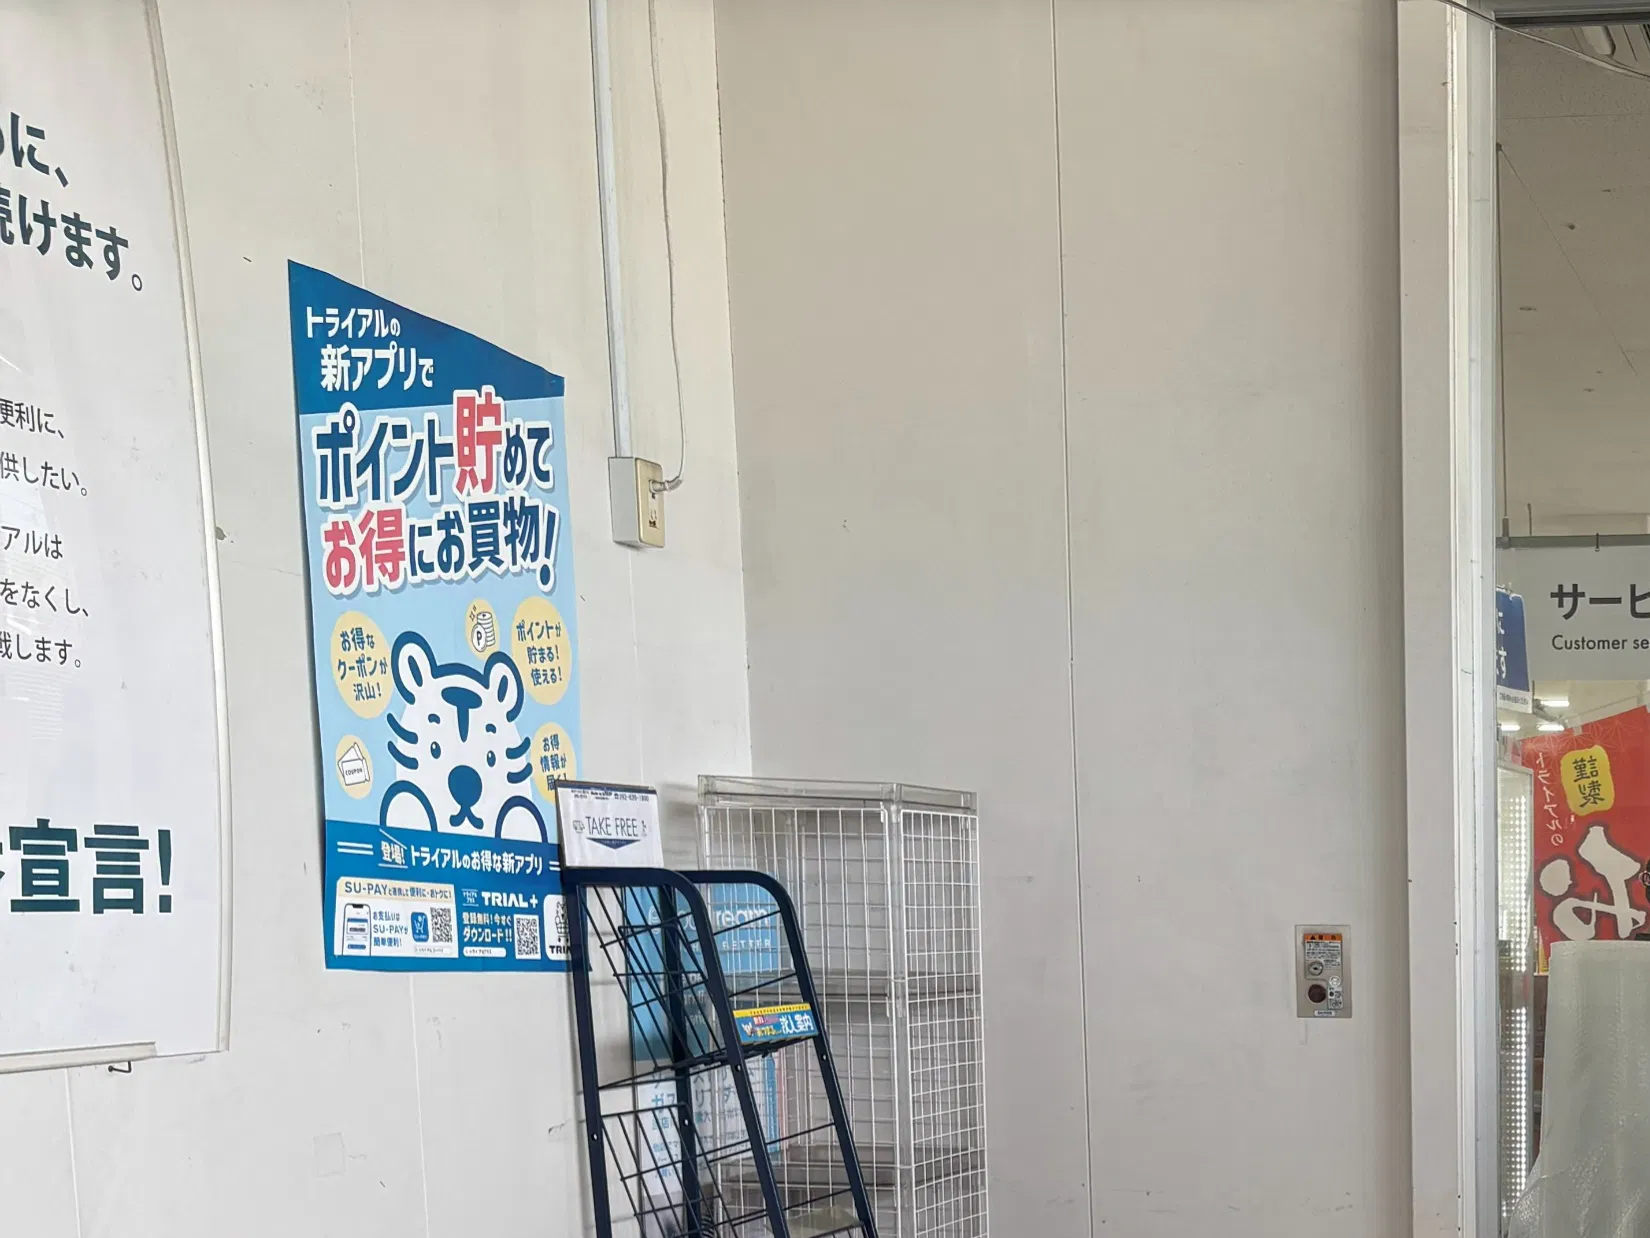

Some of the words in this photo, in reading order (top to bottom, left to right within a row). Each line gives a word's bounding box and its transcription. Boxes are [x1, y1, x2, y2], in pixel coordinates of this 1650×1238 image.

[0, 112, 69, 188] に、
[306, 306, 401, 338] トライアルの
[320, 340, 434, 392] 新アプリで
[315, 391, 552, 503] ポイント貯めて
[1, 525, 63, 560] アルは
[323, 496, 557, 588] お得にお買物!
[0, 578, 89, 618] をなくし、
[340, 627, 375, 652] お得な
[516, 619, 561, 642] ポイントが
[1551, 634, 1628, 651] Customer
[337, 654, 388, 680] クーポンが
[527, 645, 560, 664] 貯まる!
[531, 667, 563, 686] 使える!
[353, 682, 382, 701] 沢山!
[585, 816, 612, 836] TAKE
[614, 817, 639, 837] FREE
[0, 817, 172, 915] 宣言!
